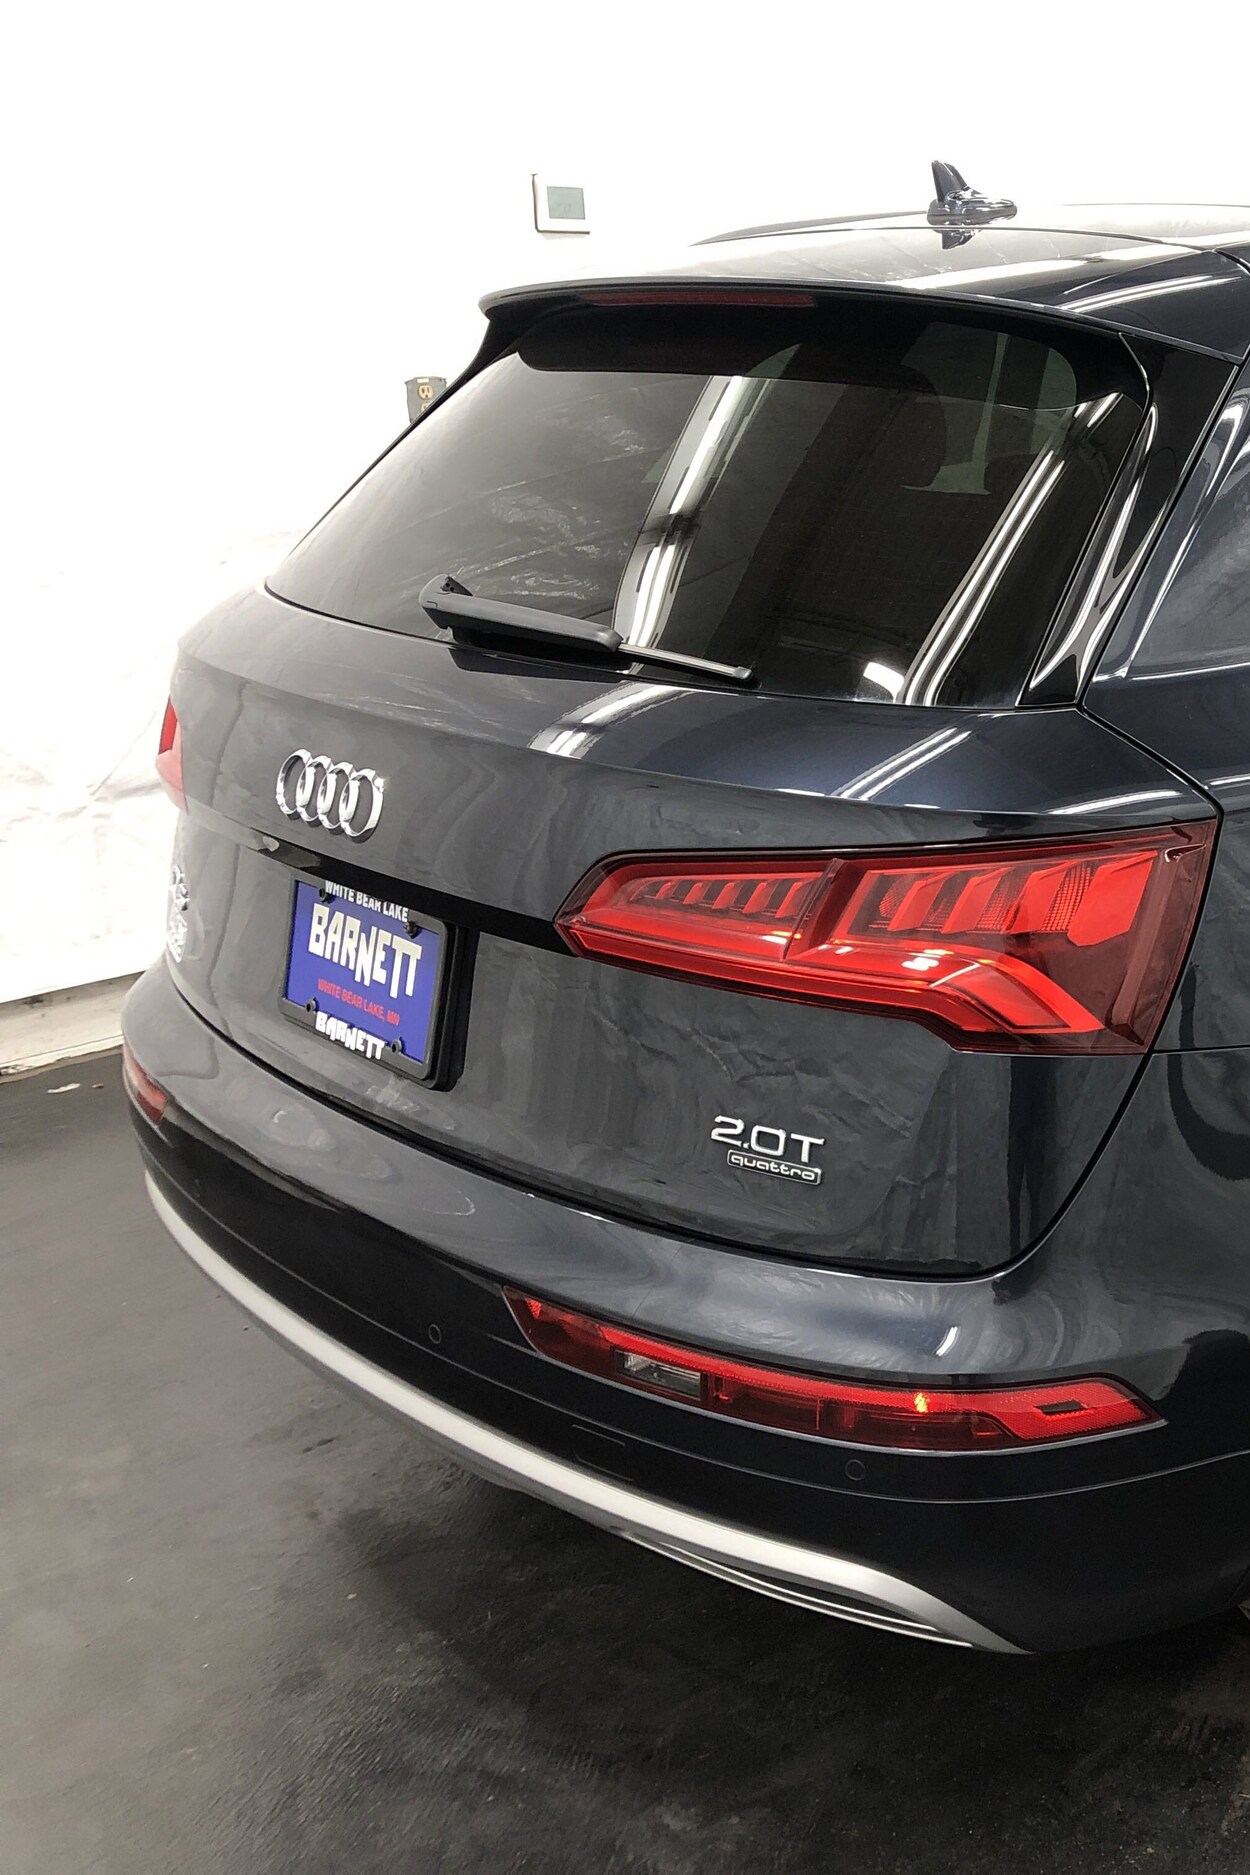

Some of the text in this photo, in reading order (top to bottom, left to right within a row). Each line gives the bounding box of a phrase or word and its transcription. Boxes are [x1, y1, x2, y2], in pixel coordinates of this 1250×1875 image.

[325, 880, 409, 923] WHITE BEAR LAKE
[308, 903, 422, 999] BARNETT
[317, 978, 400, 1026] WHITE BEAR LAKE, MN
[315, 1011, 385, 1060] BARNETT
[711, 1115, 824, 1163] 2.0T
[730, 1154, 816, 1181] quattro
